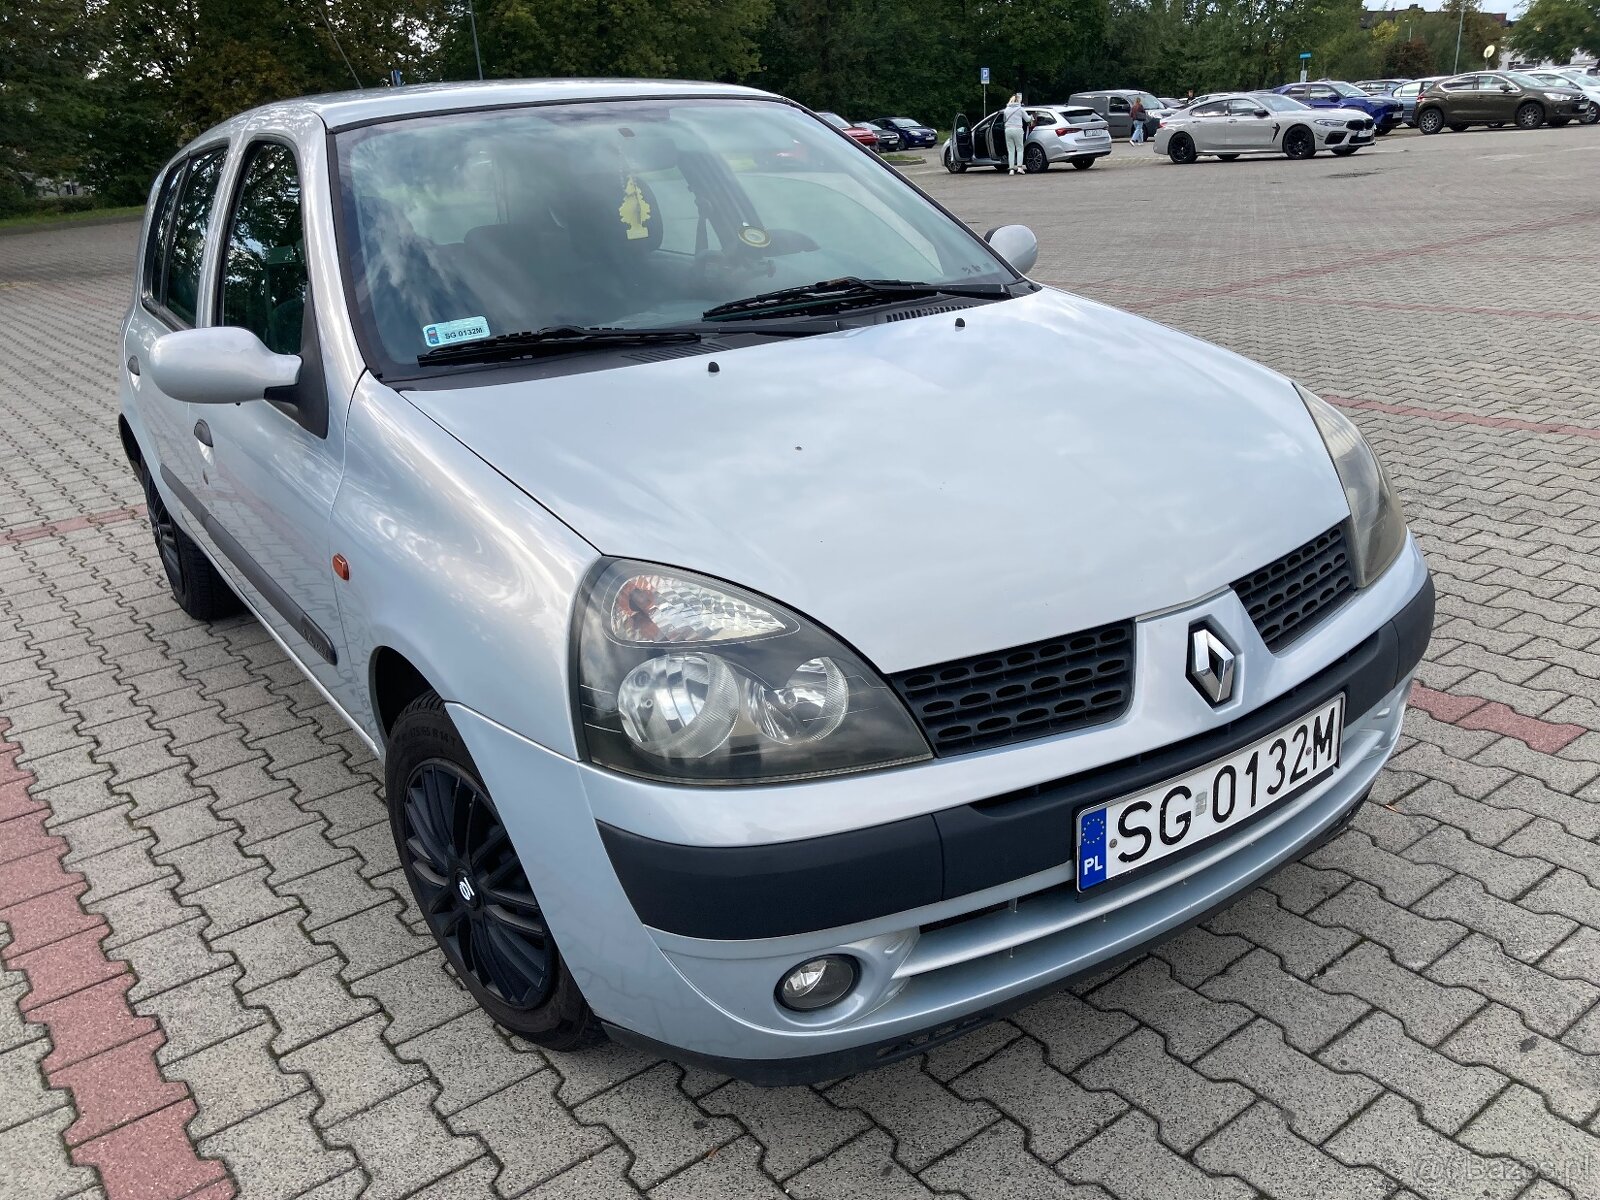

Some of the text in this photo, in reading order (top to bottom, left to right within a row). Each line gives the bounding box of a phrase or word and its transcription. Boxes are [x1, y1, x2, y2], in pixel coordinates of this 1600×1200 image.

[444, 327, 483, 340] SG 0132M
[1117, 706, 1336, 864] SG 0132M
[1083, 855, 1103, 876] PL
